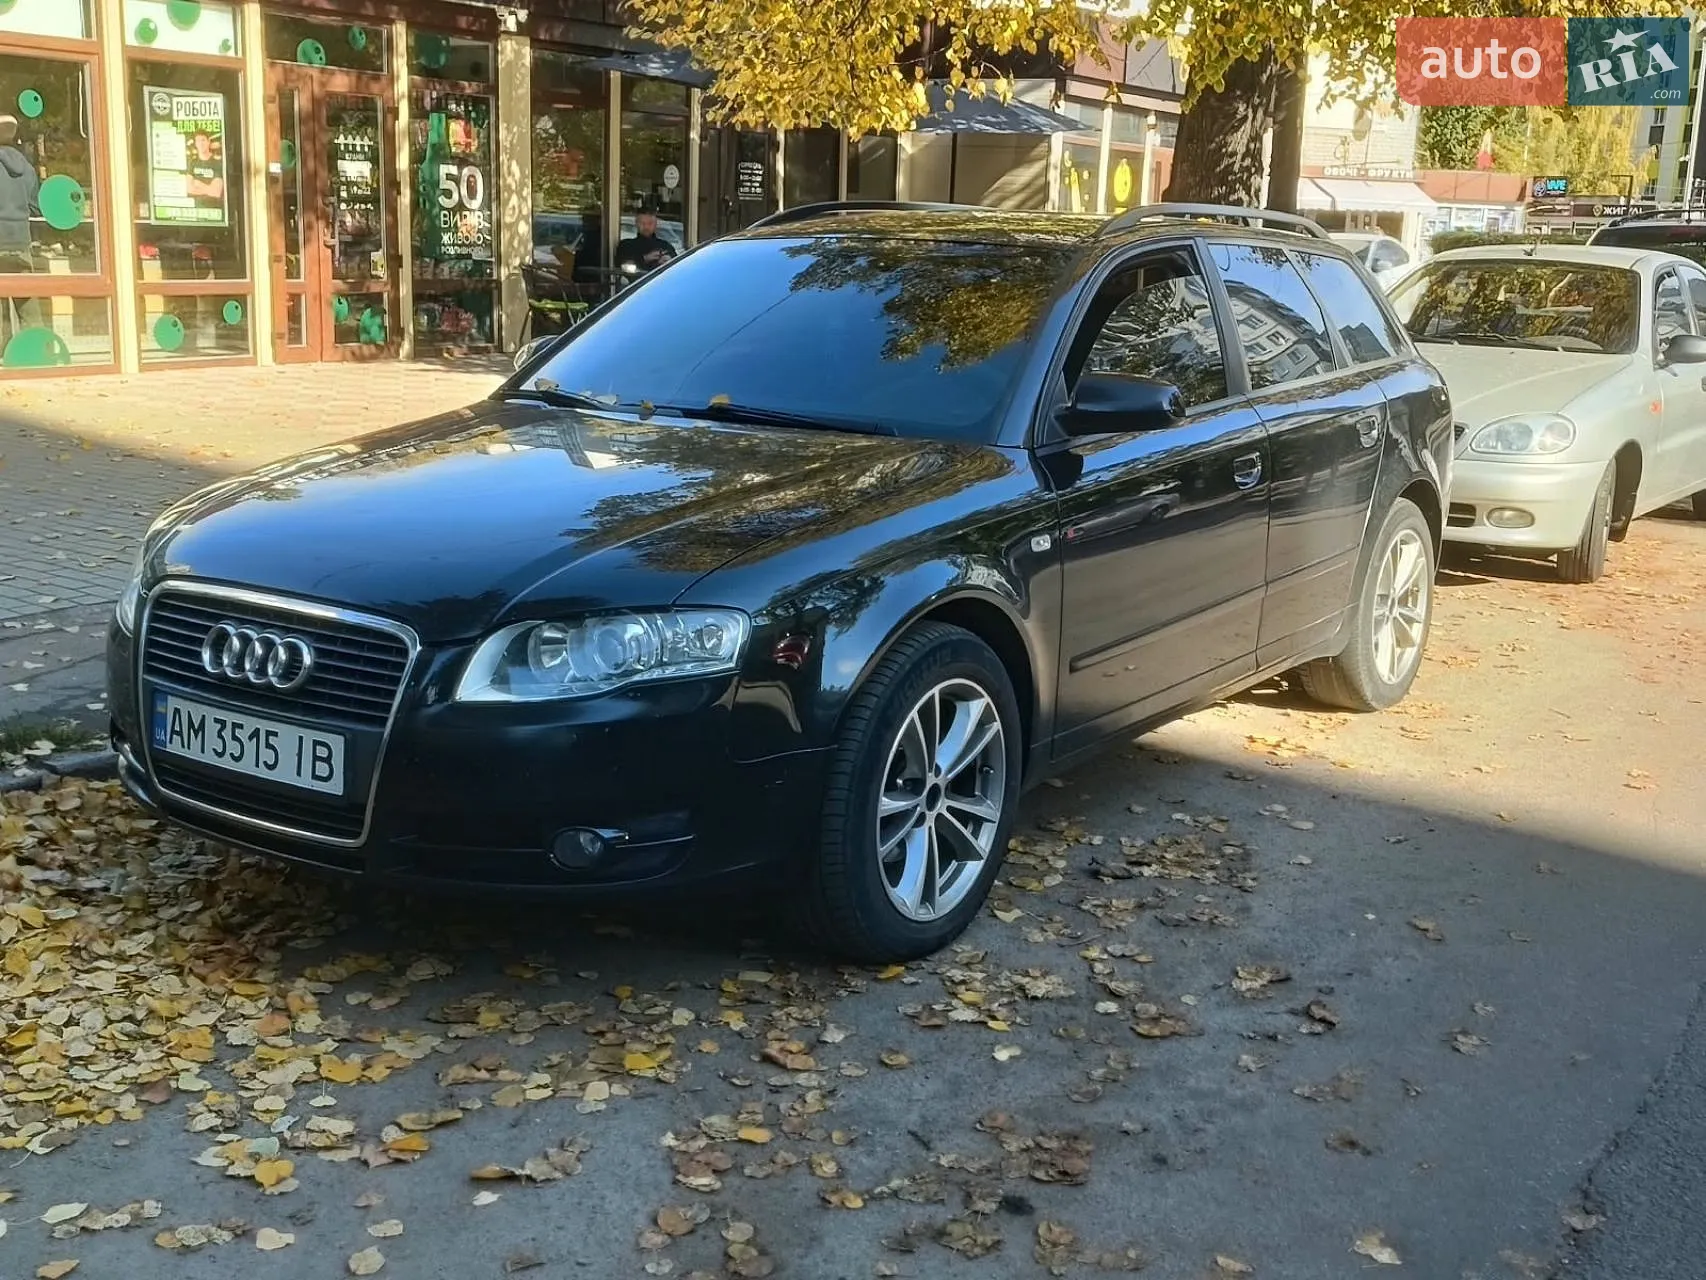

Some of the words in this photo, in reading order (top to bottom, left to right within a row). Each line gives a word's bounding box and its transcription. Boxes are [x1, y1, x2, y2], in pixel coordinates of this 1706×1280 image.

[176, 101, 220, 117] РОБОТА
[1323, 166, 1358, 177] ОВОЧІ
[438, 164, 484, 210] 50
[440, 210, 484, 229] ВИДІВ
[441, 231, 484, 245] ЖИВОГО
[155, 727, 166, 742] UA
[168, 706, 207, 755] AM
[211, 716, 280, 772] 3515
[295, 734, 335, 783] IB
